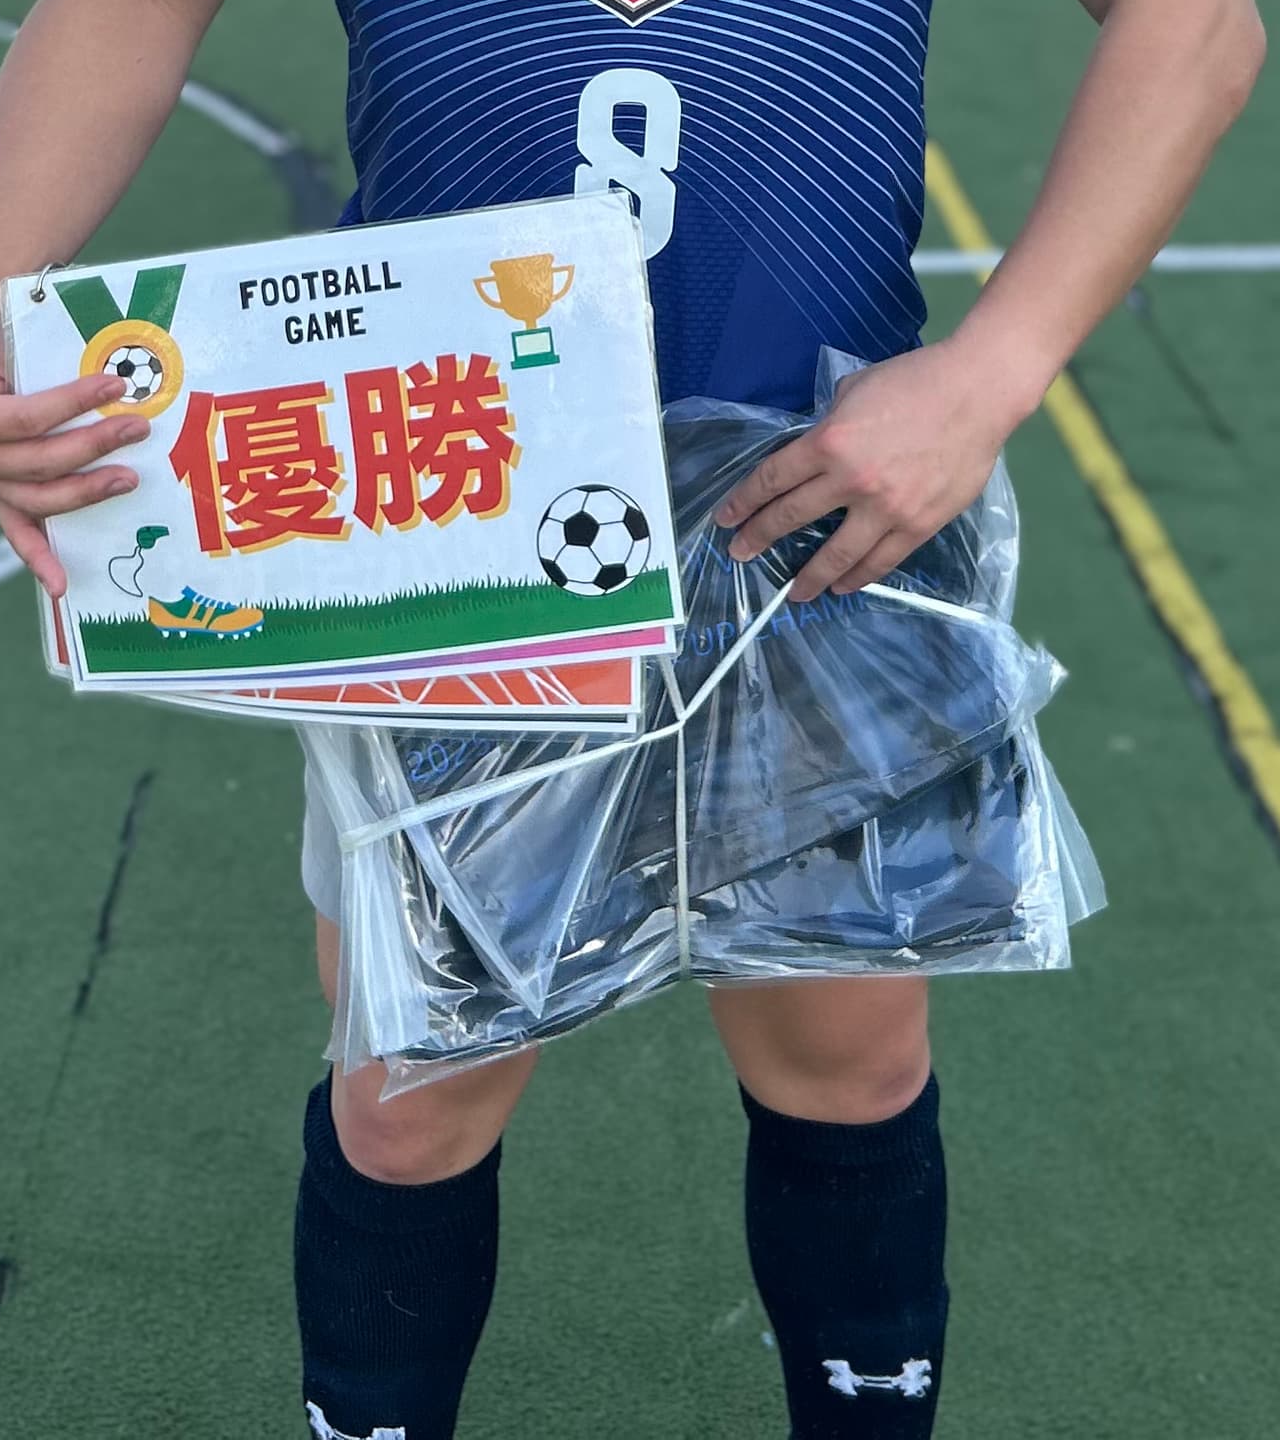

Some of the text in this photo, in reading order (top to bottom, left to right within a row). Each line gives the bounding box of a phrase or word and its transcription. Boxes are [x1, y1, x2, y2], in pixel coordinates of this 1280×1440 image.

[574, 67, 682, 261] 8
[238, 260, 403, 311] FOOTBALL
[284, 306, 367, 345] GAME
[168, 353, 520, 558] 優勝
